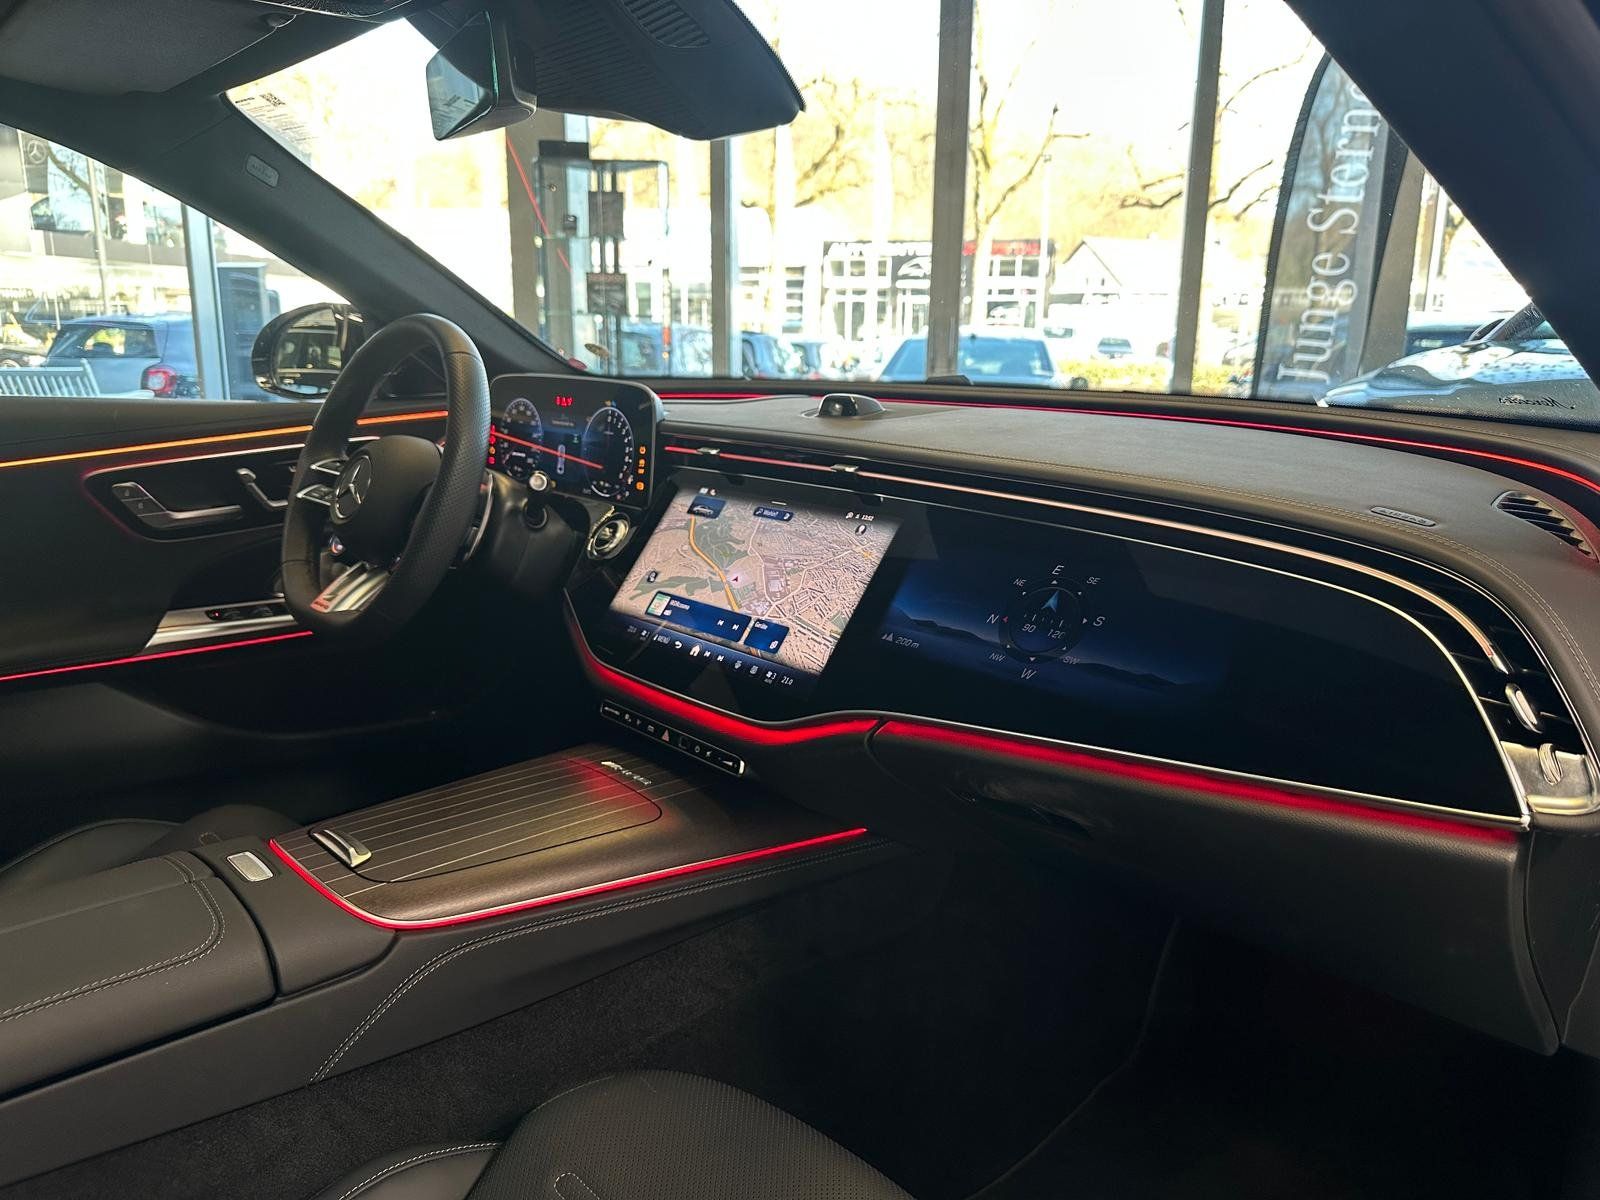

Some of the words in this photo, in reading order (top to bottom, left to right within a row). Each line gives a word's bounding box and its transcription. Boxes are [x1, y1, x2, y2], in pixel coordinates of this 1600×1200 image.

[1276, 251, 1358, 385] Junge
[1052, 565, 1064, 575] E
[1013, 578, 1027, 587] NE
[1086, 576, 1100, 585] SE
[986, 614, 1000, 624] N
[1092, 616, 1105, 627] S
[1022, 623, 1037, 633] 90
[988, 652, 1006, 662] NW
[1063, 655, 1080, 665] SW
[1021, 668, 1037, 680] W
